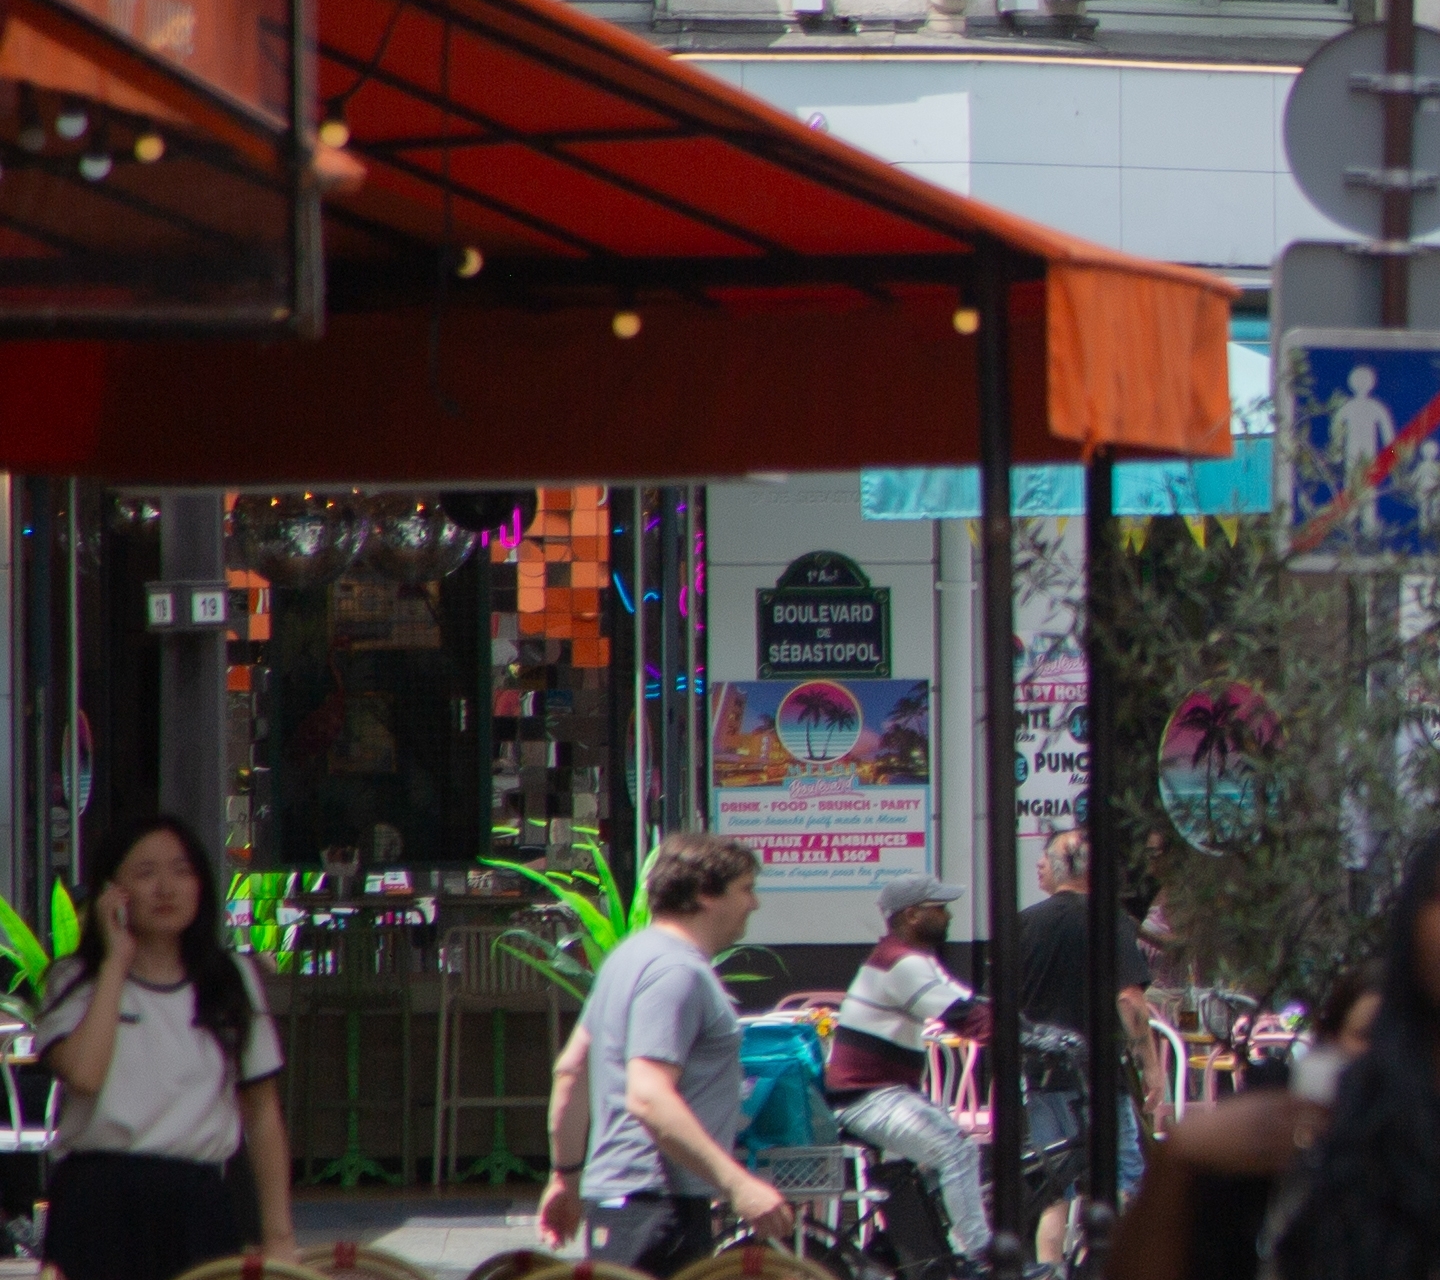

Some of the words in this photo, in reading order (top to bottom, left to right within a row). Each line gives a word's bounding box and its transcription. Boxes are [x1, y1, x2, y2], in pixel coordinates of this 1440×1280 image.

[199, 595, 219, 619] 19
[773, 605, 874, 624] BOULEVARD
[816, 628, 831, 638] DE
[769, 638, 880, 662] SÉBASTOPOL
[721, 800, 761, 813] DRINK
[771, 800, 808, 812] FOOD
[818, 799, 871, 811] BRUNCH
[880, 799, 921, 811] PARTY
[830, 835, 909, 847] AMBIANCES
[772, 850, 800, 863] BAR
[802, 850, 828, 862] XXL
[830, 847, 841, 862] À
